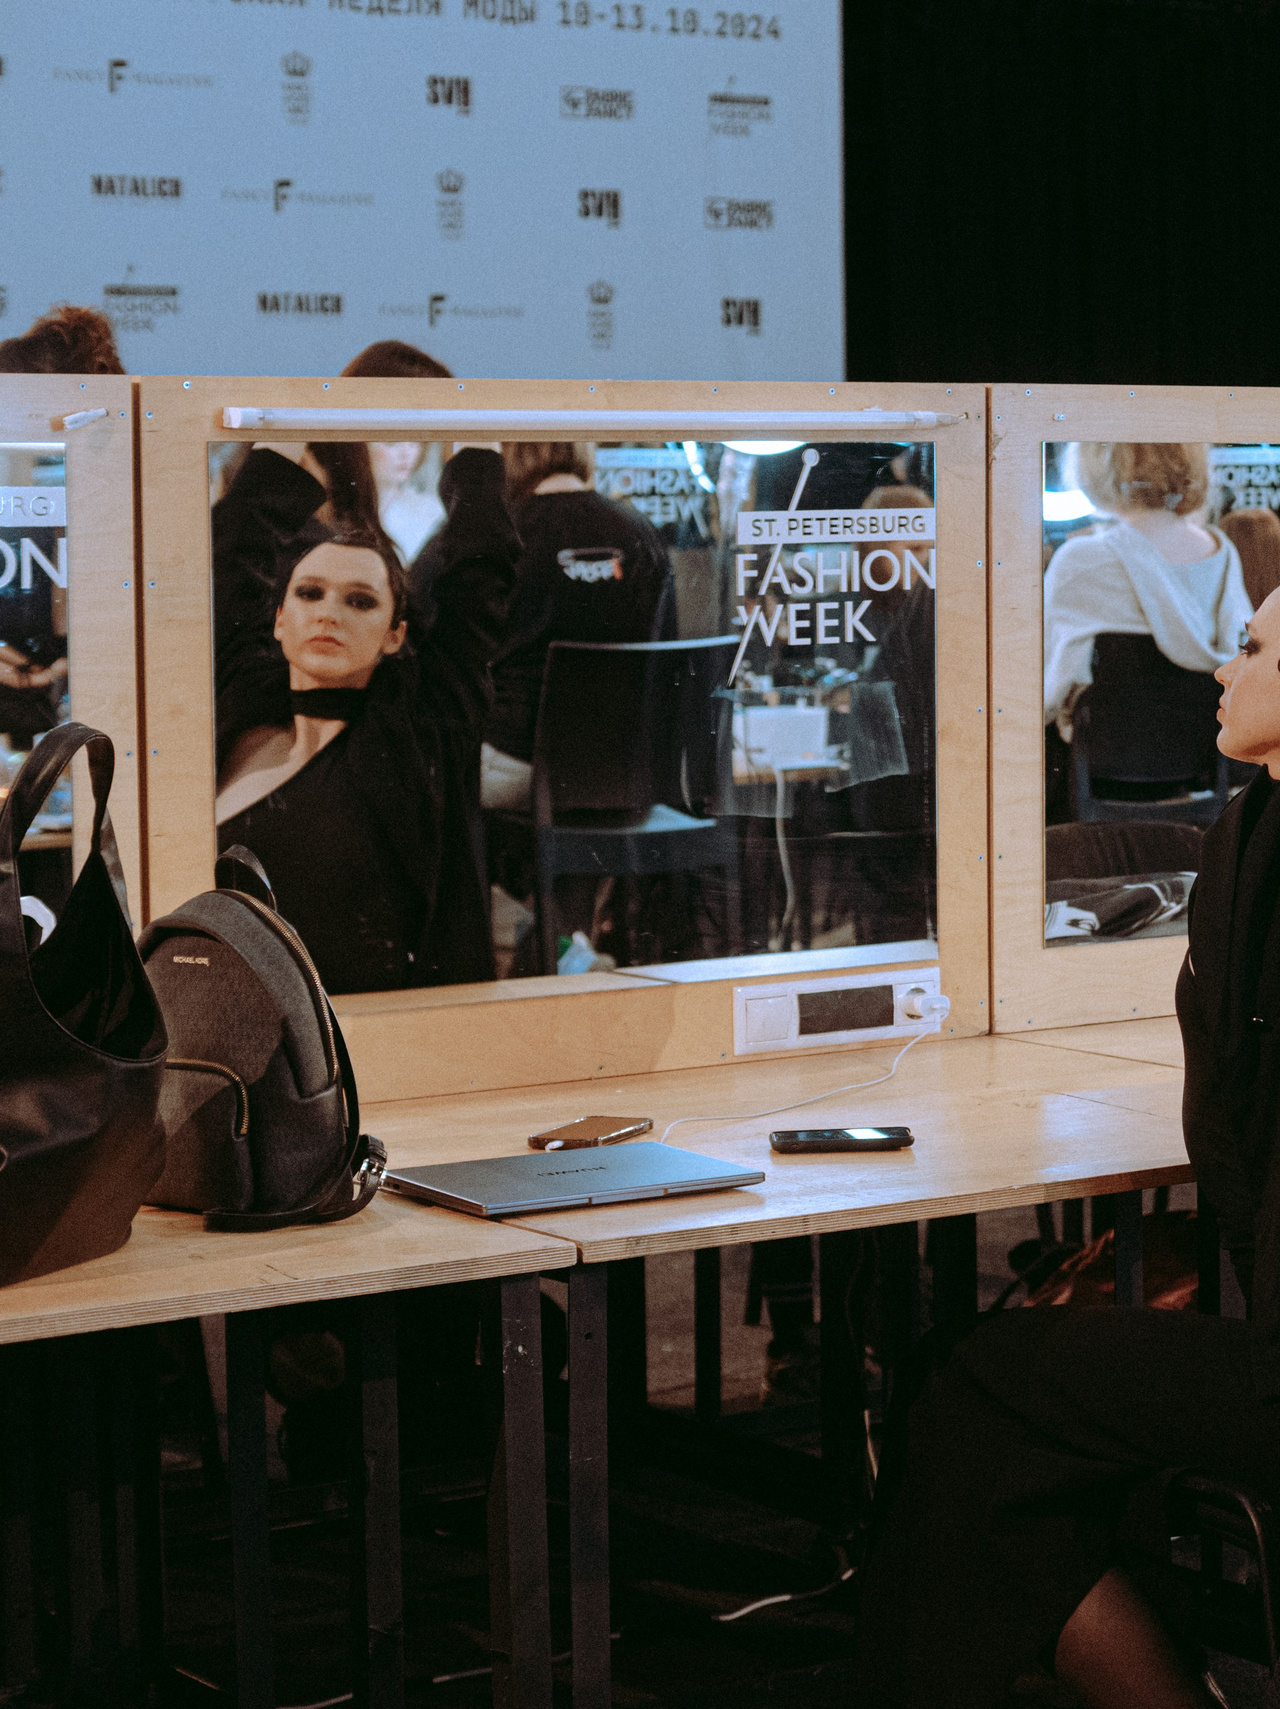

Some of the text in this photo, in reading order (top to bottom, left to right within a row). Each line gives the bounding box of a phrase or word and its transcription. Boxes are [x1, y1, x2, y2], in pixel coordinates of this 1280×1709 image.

[751, 515, 926, 538] ST. PETERSBURG
[735, 548, 936, 597] FASHION
[735, 599, 877, 648] WEEK
